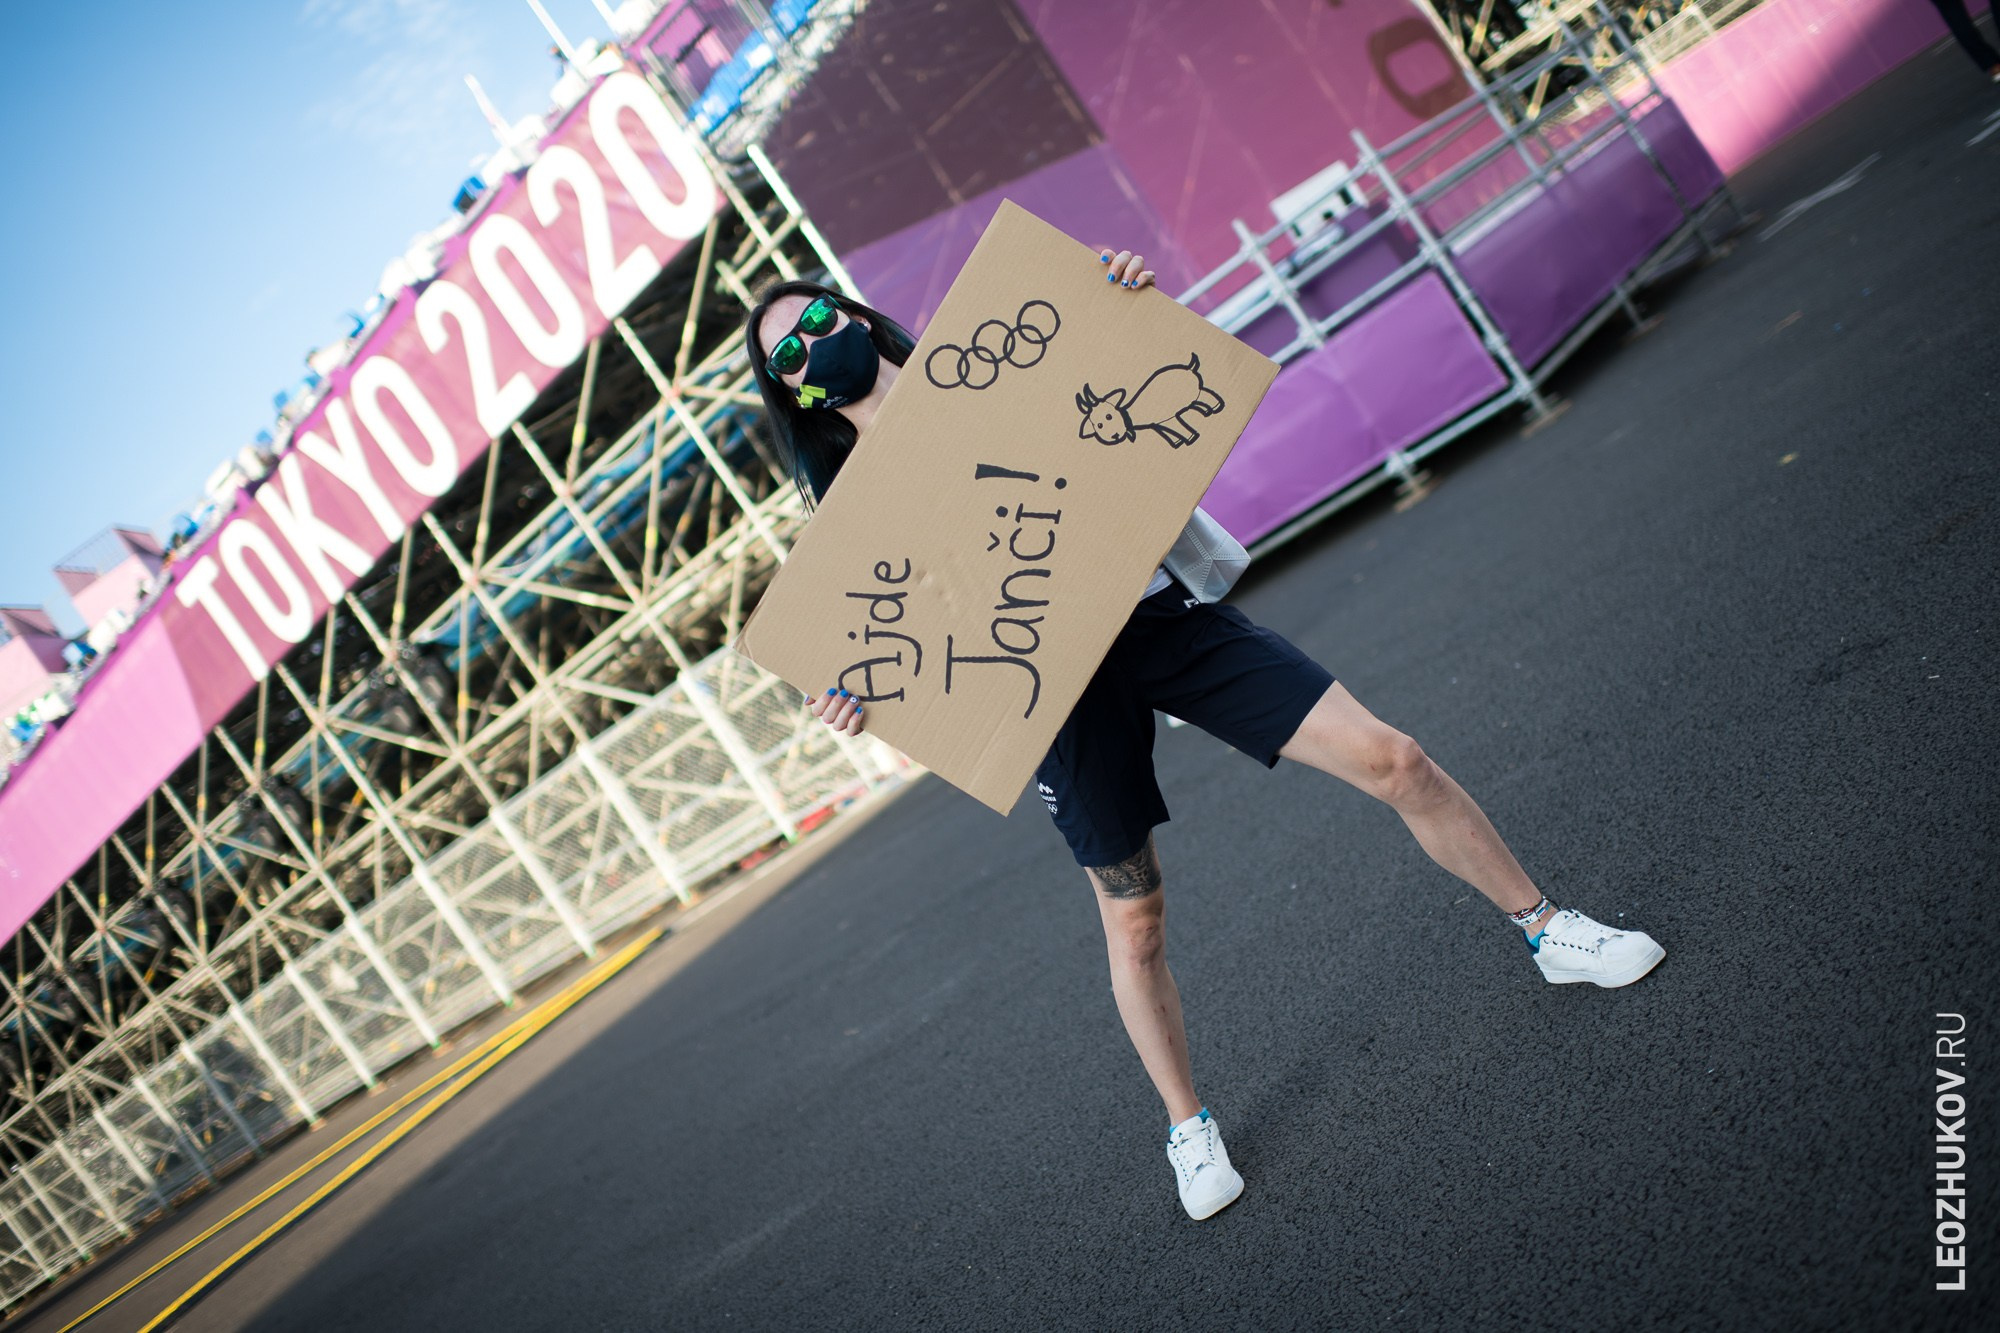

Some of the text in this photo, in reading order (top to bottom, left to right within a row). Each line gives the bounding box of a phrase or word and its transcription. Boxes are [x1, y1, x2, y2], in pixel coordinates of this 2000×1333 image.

[175, 71, 718, 682] TOKYO 2020
[837, 557, 923, 703] Ajde
[944, 462, 1068, 720] Janči!
